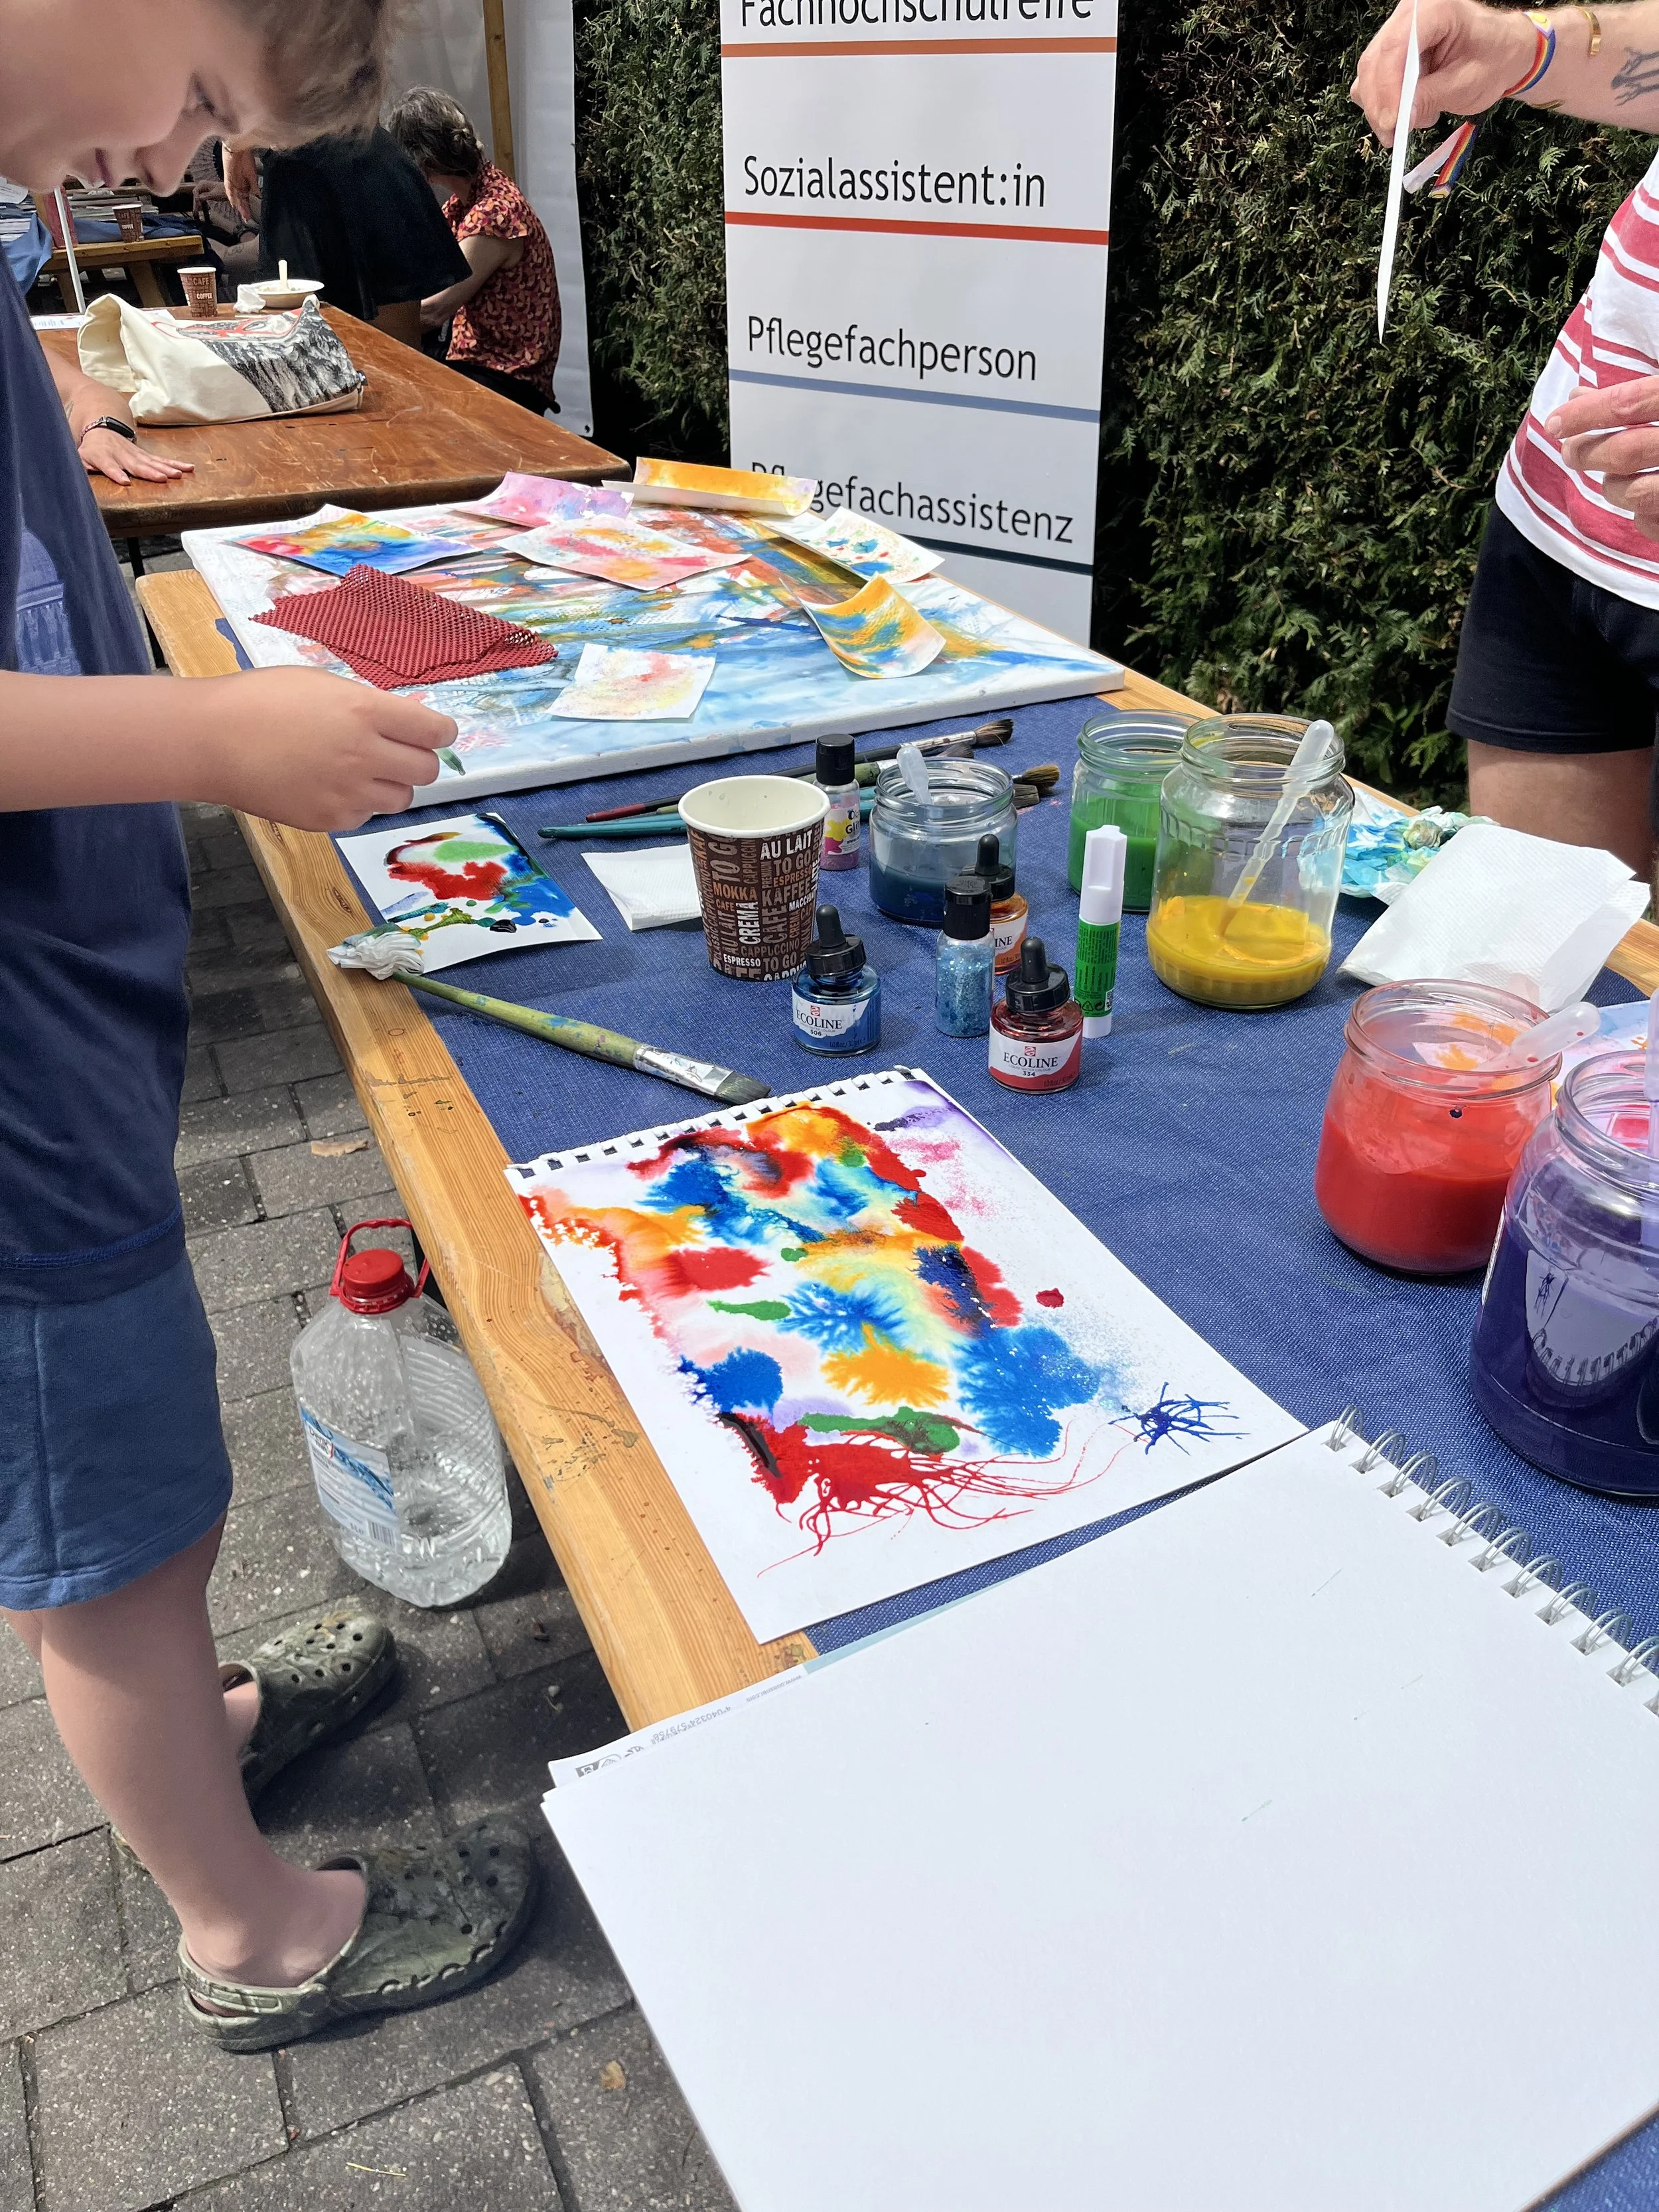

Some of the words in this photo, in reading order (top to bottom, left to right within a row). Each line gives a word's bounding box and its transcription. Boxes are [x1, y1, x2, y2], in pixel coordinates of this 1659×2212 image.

[744, 155, 1045, 208] Sozialassistent:in
[193, 277, 210, 285] CAFE
[748, 315, 1037, 381] Pflegefachperson
[751, 461, 1073, 544] gefachassistenz
[760, 840, 781, 860] AU
[786, 829, 813, 855] LAIT
[710, 859, 741, 883] TO
[760, 861, 772, 889] PREMIUM
[773, 857, 792, 877] TO
[796, 849, 811, 870] GO
[773, 865, 812, 887] ESPRESSO
[713, 881, 758, 901] MOKKA
[761, 876, 811, 907] KAFFEE
[715, 899, 735, 912] CAFE
[717, 910, 737, 937] LAIT
[735, 901, 762, 945] CREMA
[761, 904, 788, 944] CAFE
[788, 909, 801, 939] CREMA
[721, 937, 741, 956] AU
[741, 938, 800, 957] CAPPUCCINO
[723, 953, 761, 968] ESPRESSO
[762, 956, 779, 973] TO
[782, 951, 797, 969] GO
[796, 1009, 843, 1029] ECOLINE
[1003, 1051, 1058, 1069] ECOLINE
